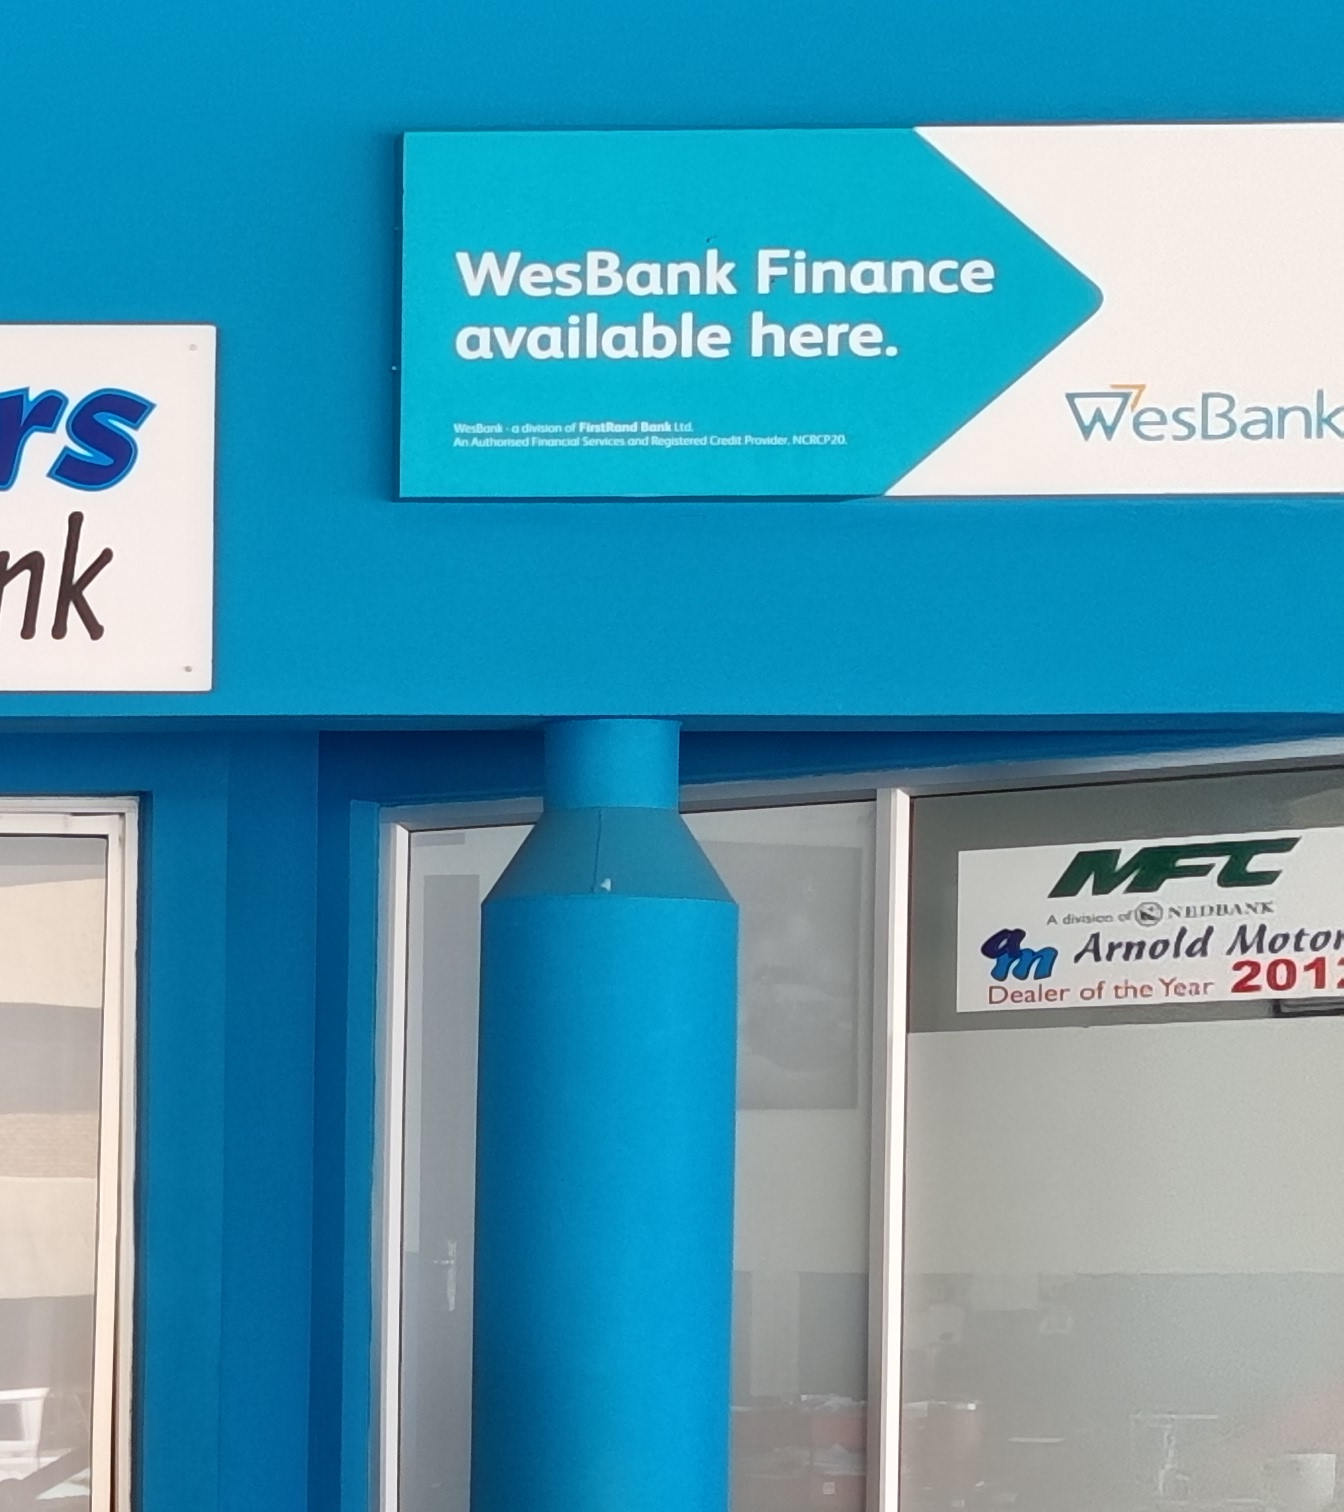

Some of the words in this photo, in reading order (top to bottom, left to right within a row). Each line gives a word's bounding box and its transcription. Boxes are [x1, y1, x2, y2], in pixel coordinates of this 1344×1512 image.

[454, 248, 738, 298] WesBank
[756, 248, 996, 296] Finance
[454, 312, 732, 361] available
[750, 311, 899, 358] here.
[453, 423, 503, 434] WesBank
[521, 423, 562, 433] division
[564, 422, 577, 433] of
[578, 421, 638, 433] FirstRand
[640, 421, 672, 432] Bank
[673, 421, 694, 432] Ltd.
[1064, 384, 1344, 442] WesBank
[453, 437, 469, 447] An
[531, 437, 580, 447] Financial
[582, 436, 625, 447] Services
[627, 435, 649, 446] and
[651, 436, 707, 448] Registered
[709, 435, 742, 446] Credit
[1046, 914, 1058, 926] A
[1062, 912, 1114, 925] division
[1073, 925, 1214, 964] Arnold
[988, 983, 1071, 1005] Dealer
[1079, 980, 1106, 1001] of
[1113, 979, 1153, 999] the
[1158, 976, 1215, 998] Year
[1231, 956, 1344, 993] 201
